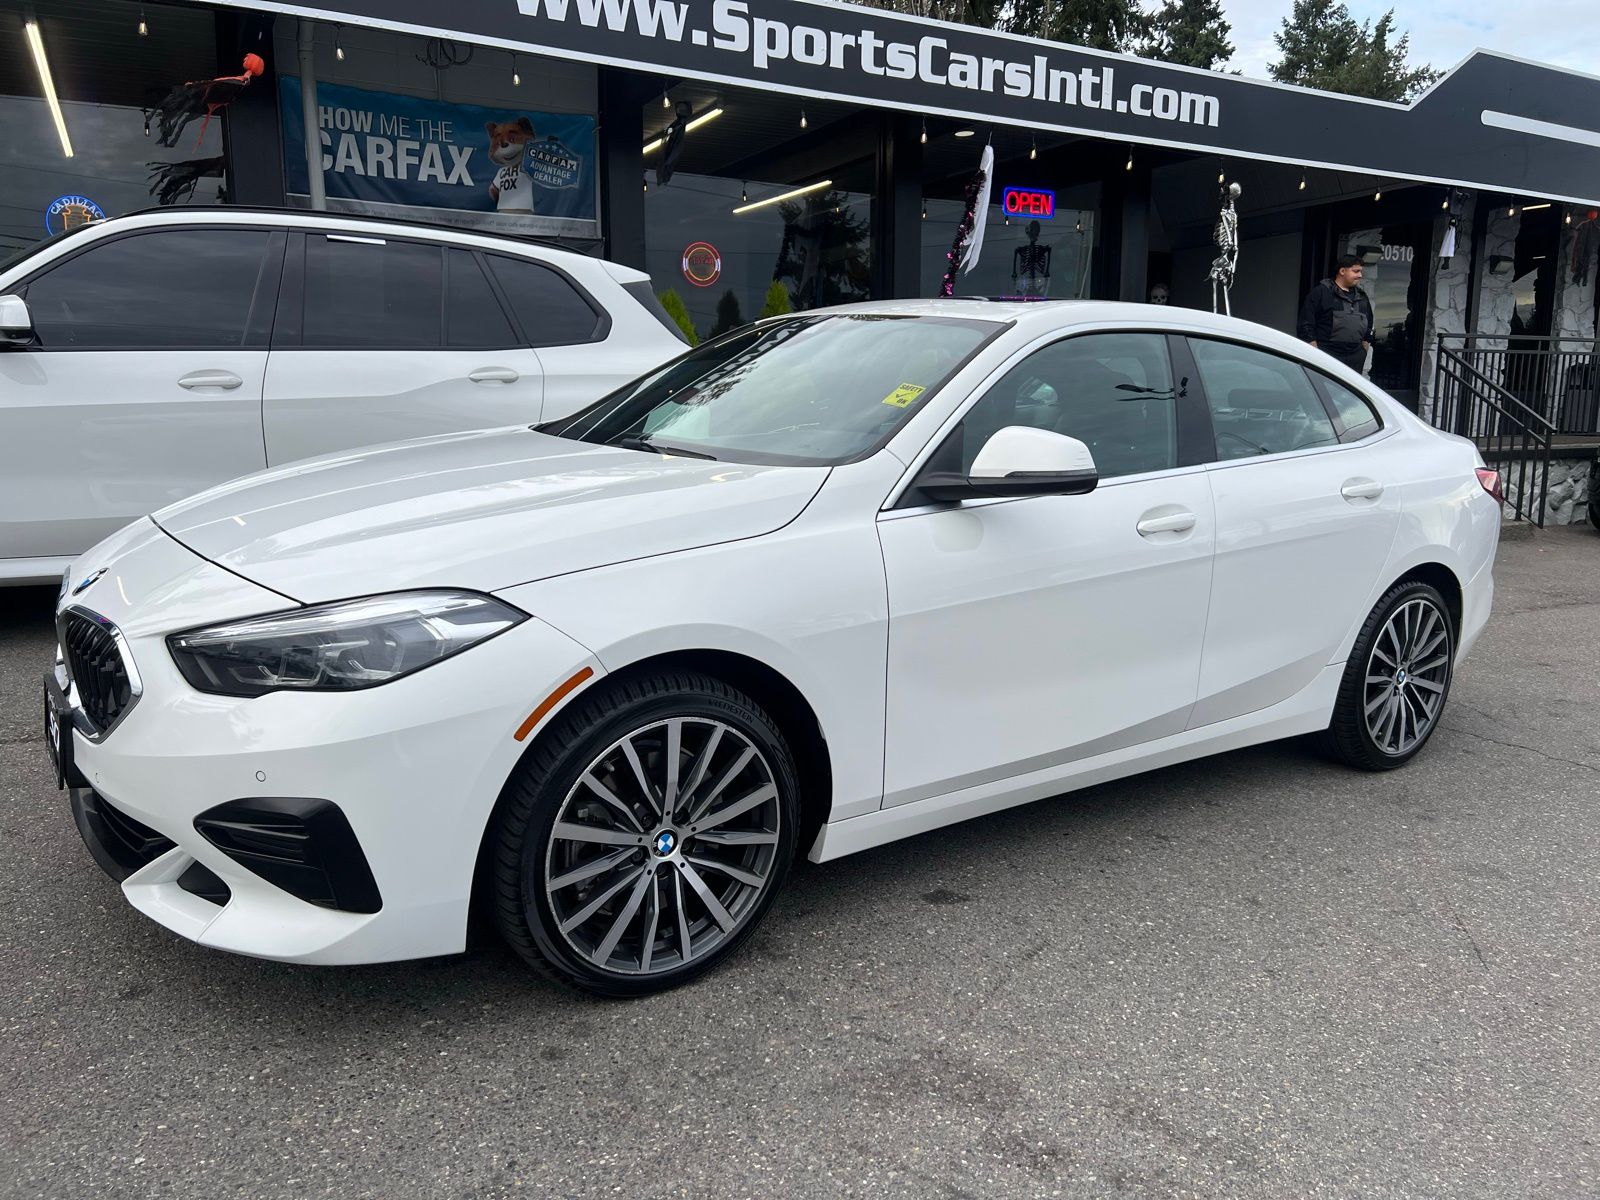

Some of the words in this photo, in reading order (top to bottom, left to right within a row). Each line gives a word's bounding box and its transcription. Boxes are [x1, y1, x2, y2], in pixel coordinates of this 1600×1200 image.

[318, 105, 373, 132] HOW
[380, 113, 411, 138] ME
[415, 119, 454, 143] THE
[529, 149, 577, 171] CARFAX
[500, 167, 519, 179] CAR
[530, 161, 571, 179] ADVANTAGE
[533, 172, 562, 186] DEALER
[500, 178, 517, 192] FOX
[50, 197, 102, 218] CADILLAC
[1006, 191, 1052, 215] OPEN
